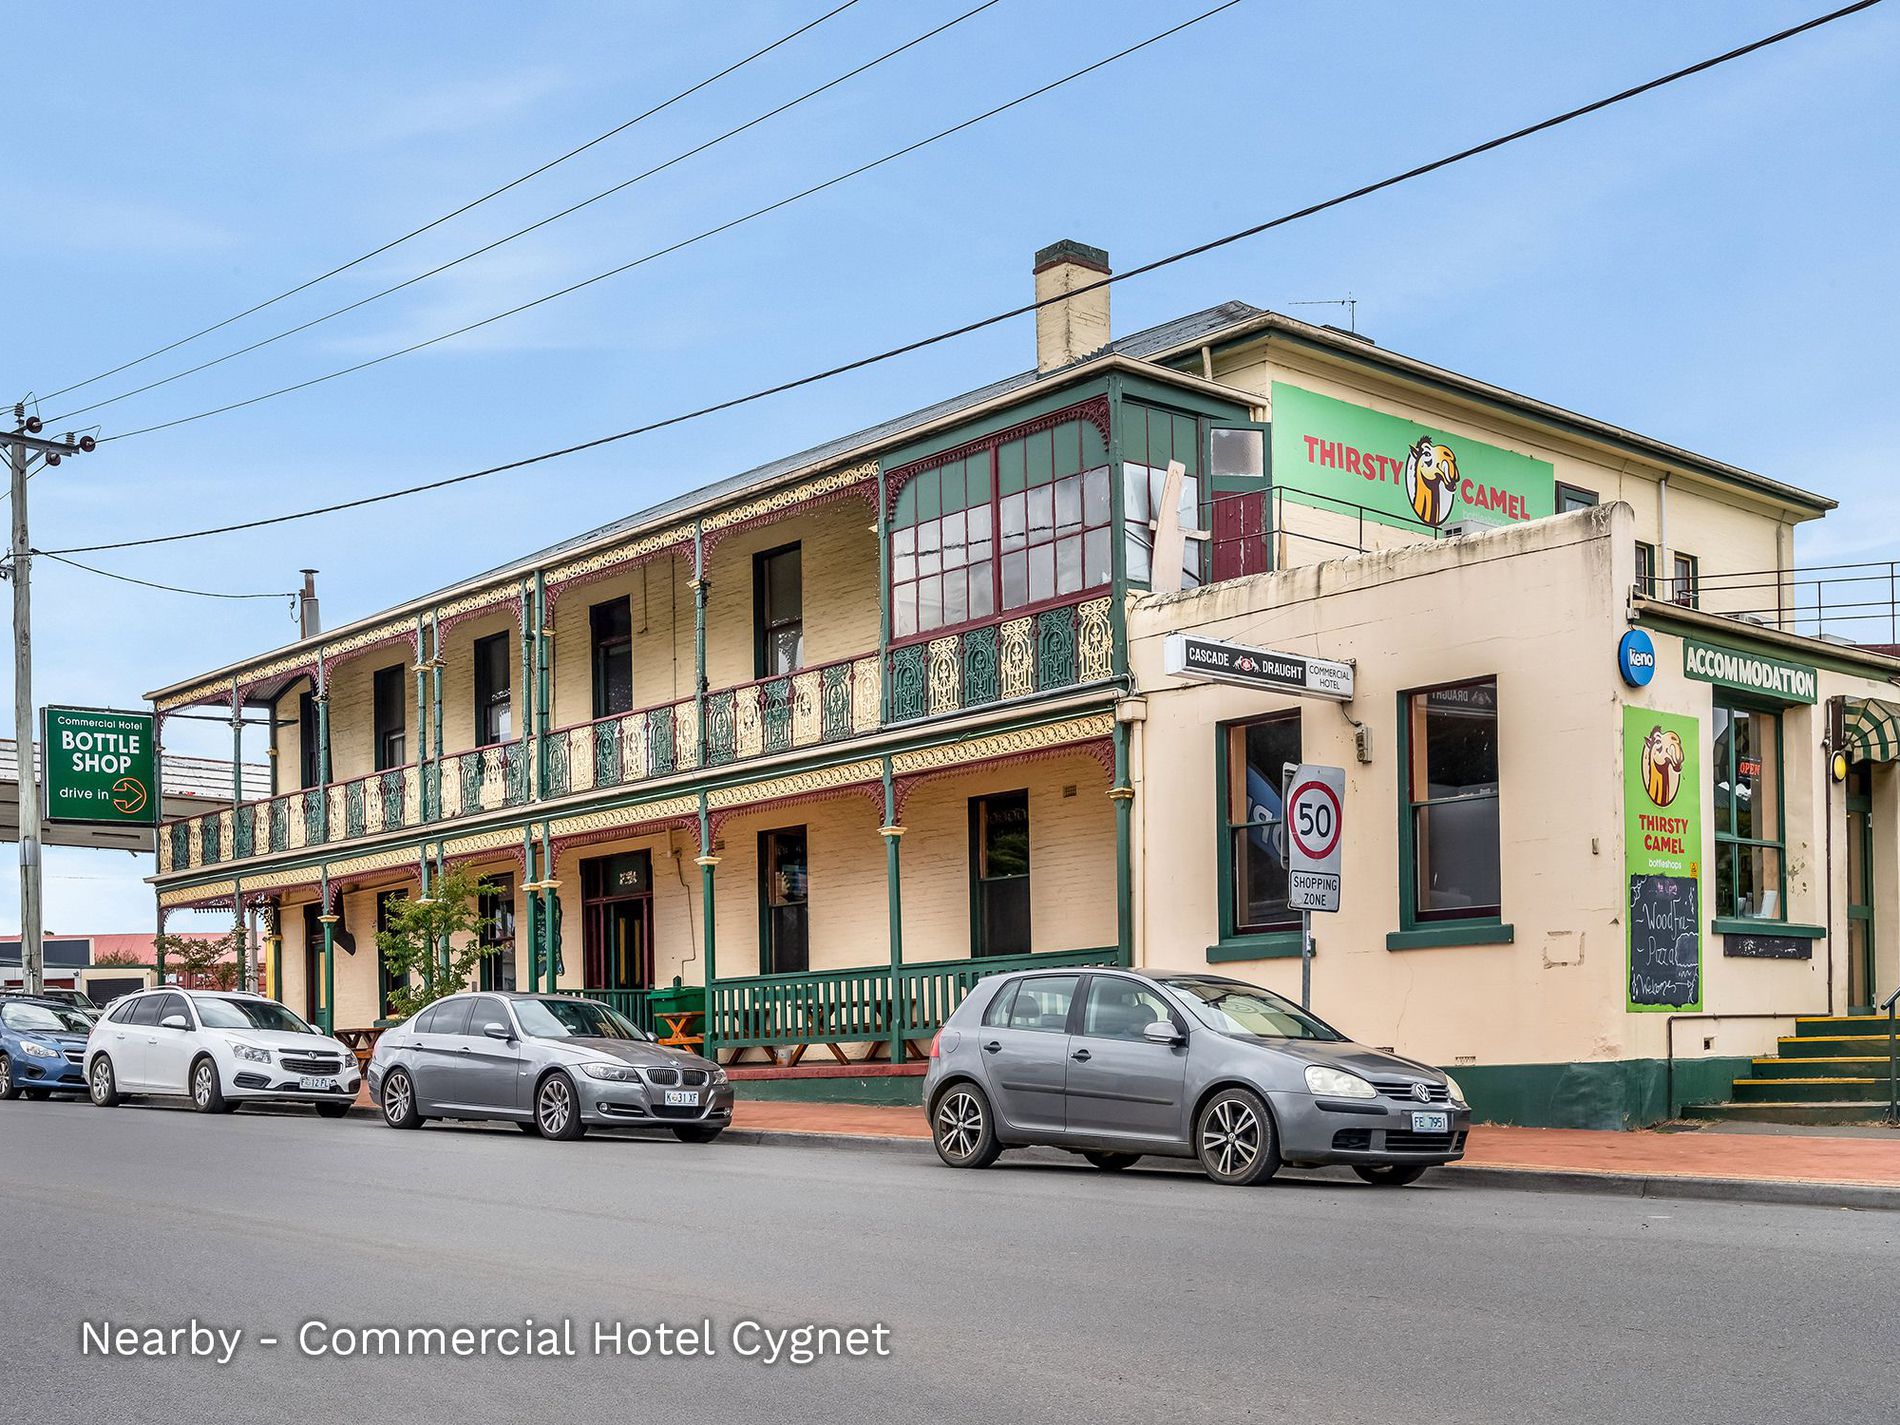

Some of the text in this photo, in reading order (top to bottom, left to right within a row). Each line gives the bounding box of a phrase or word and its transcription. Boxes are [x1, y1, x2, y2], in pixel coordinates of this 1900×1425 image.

[1304, 435, 1530, 520] THIRSTY CAMEL
[1189, 647, 1303, 679] CASCADE DRAUGHT
[1629, 647, 1653, 668] keno
[1309, 664, 1350, 681] COMMERCIAL
[1686, 646, 1814, 697] ACCOMMODATION
[1319, 678, 1340, 690] HOTEL
[57, 716, 143, 731] Commercial Hotel
[62, 731, 140, 754] BOTTLE
[72, 752, 131, 774] SHOP
[1739, 762, 1761, 776] OPEN
[60, 786, 109, 800] drive in
[1299, 802, 1331, 838] 50
[1638, 814, 1688, 834] THIRSTY
[1644, 834, 1684, 854] CAMEL
[1293, 876, 1337, 891] SHOPPING
[1303, 893, 1326, 906] ZONE
[666, 1093, 671, 1101] K
[678, 1093, 686, 1102] 31
[1414, 1116, 1424, 1127] FE
